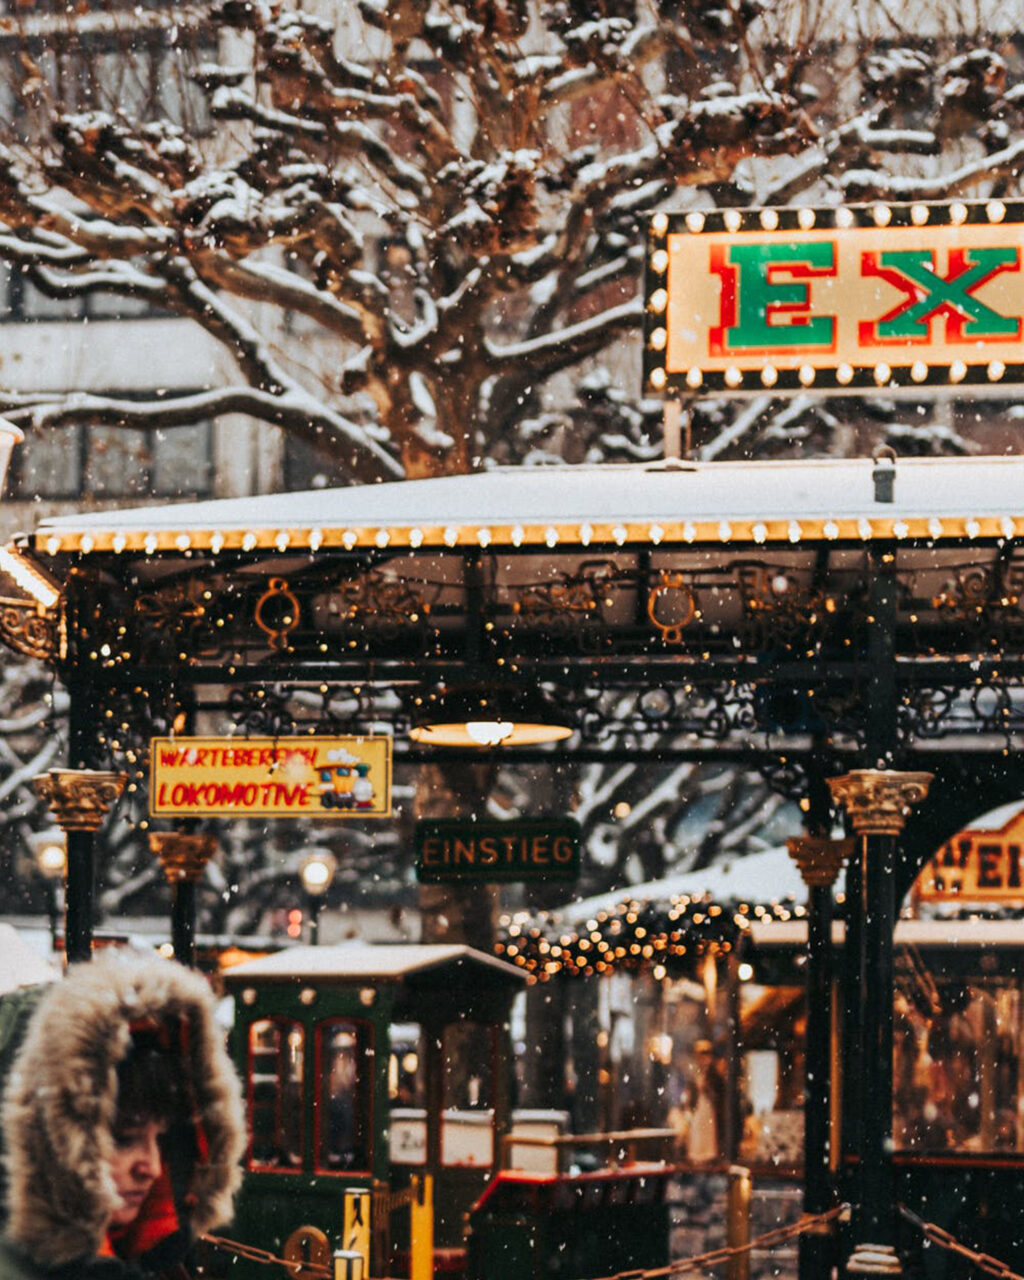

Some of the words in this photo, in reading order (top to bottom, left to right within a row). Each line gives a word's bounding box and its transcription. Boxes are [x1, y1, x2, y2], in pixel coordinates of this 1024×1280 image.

[708, 240, 1022, 358] EX
[158, 782, 315, 808] LOKOMOTIVE
[422, 836, 573, 865] EINSTIEG
